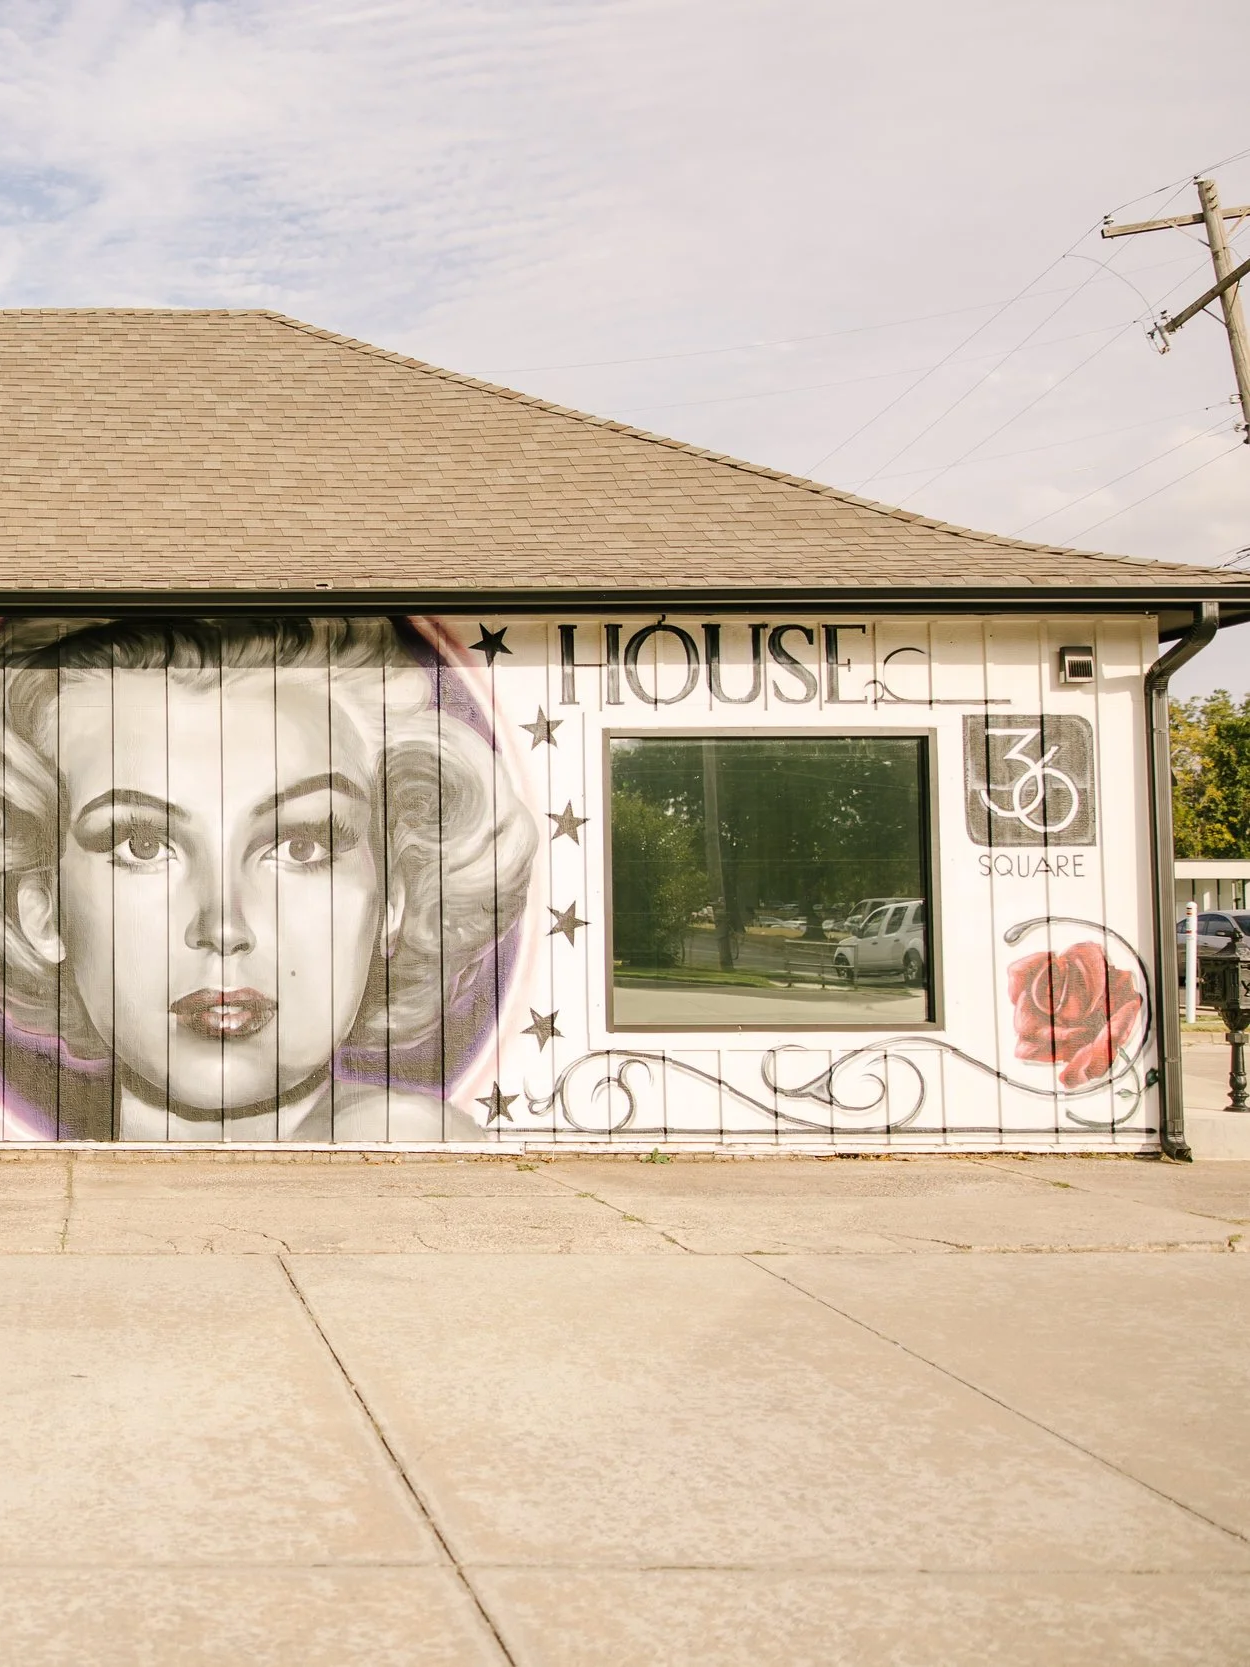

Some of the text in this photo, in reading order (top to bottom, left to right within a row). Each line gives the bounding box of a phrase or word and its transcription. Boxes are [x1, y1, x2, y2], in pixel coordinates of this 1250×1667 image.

[557, 624, 868, 706] HOUSE
[979, 728, 1079, 834] 36
[978, 853, 1086, 878] SQUARE
